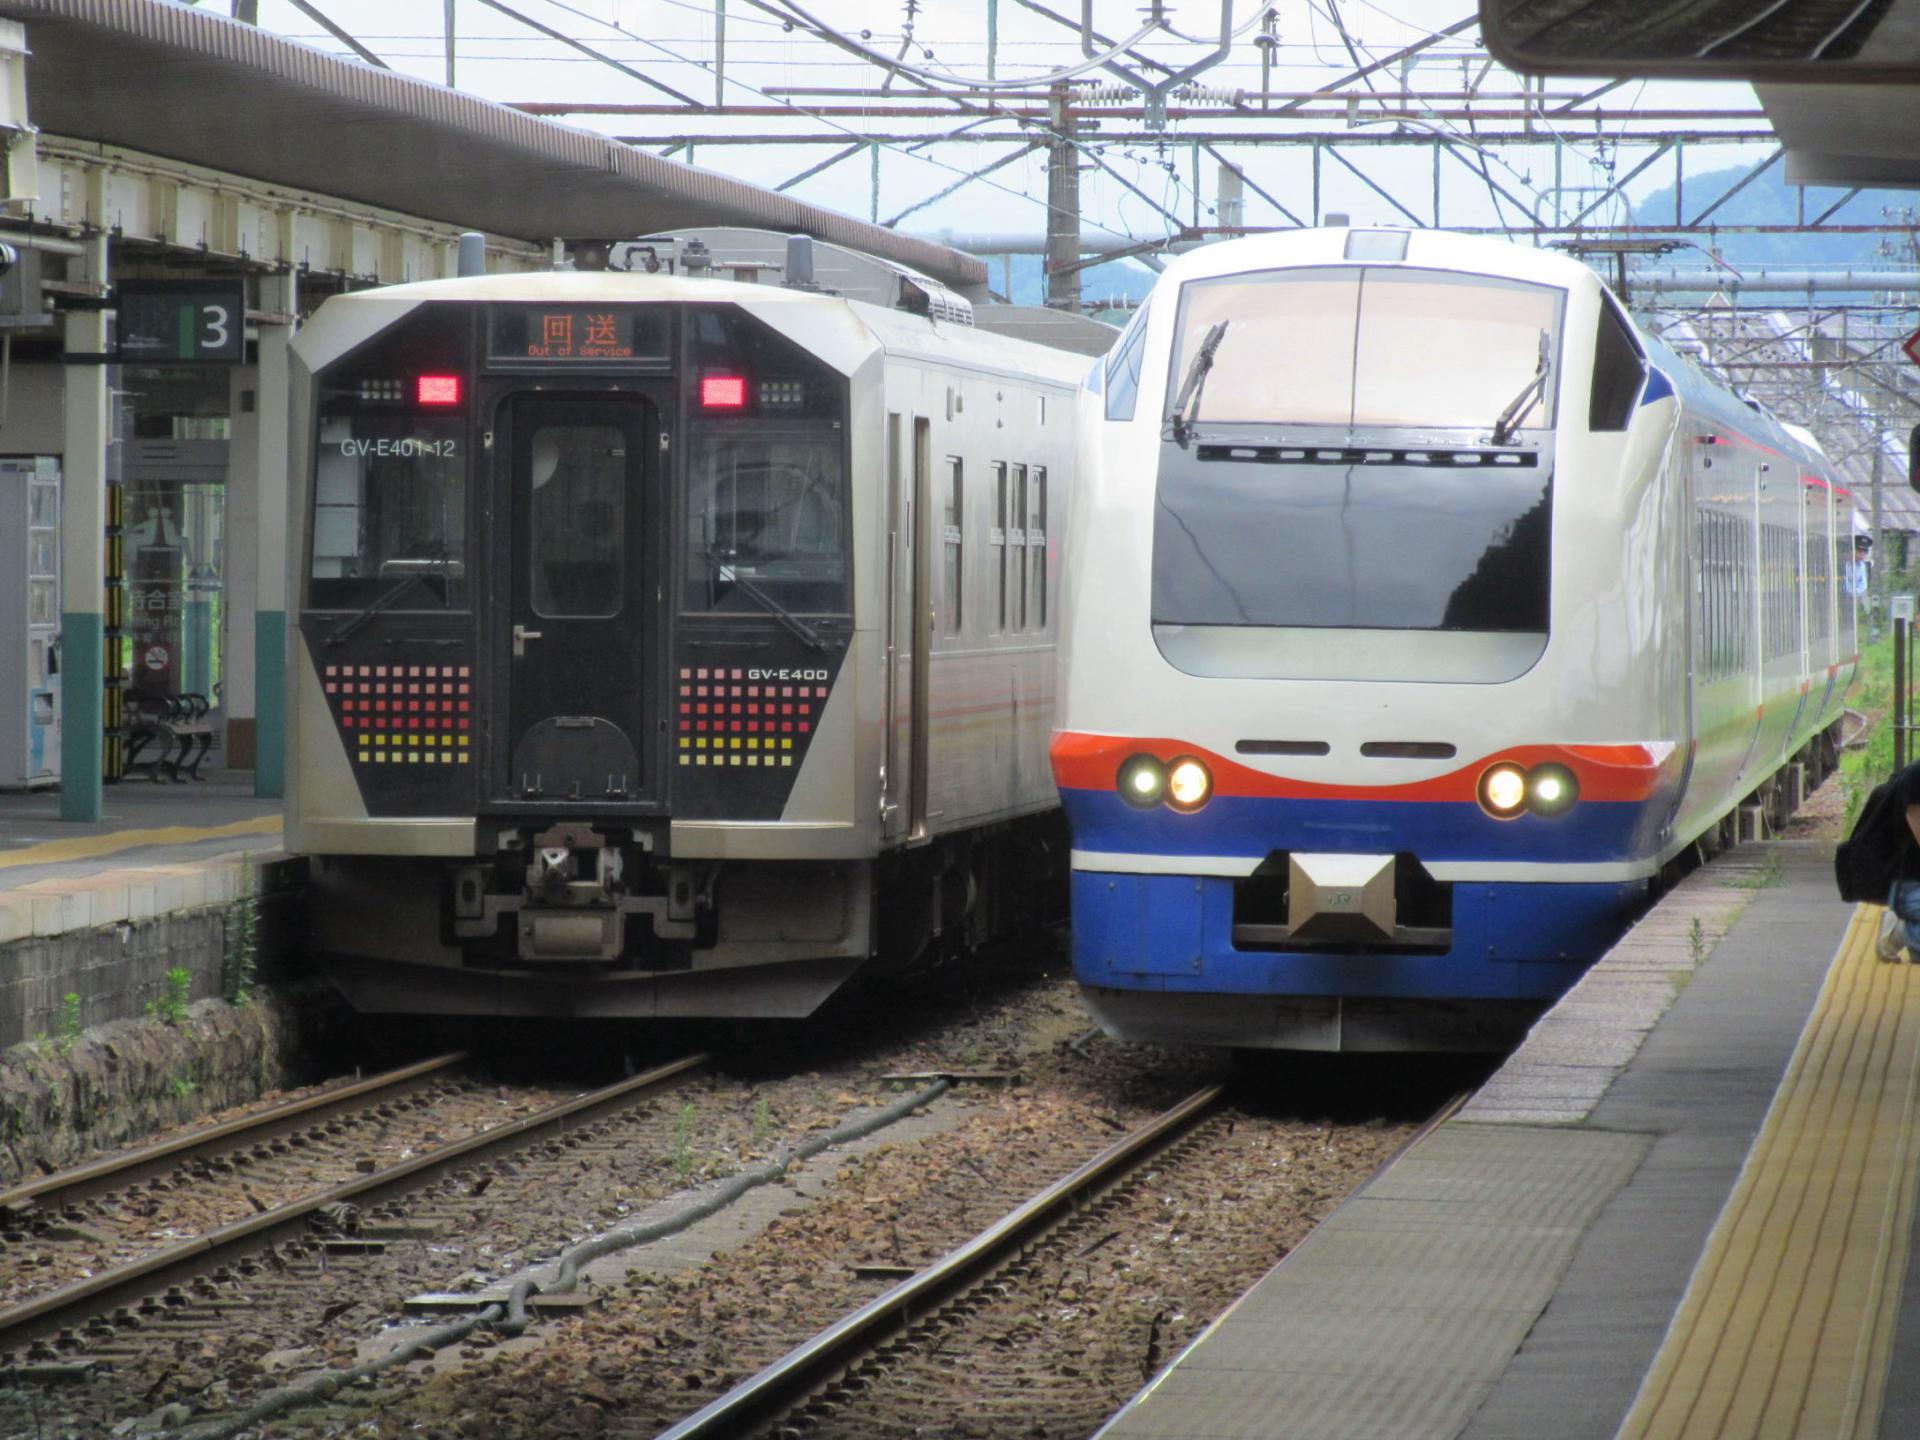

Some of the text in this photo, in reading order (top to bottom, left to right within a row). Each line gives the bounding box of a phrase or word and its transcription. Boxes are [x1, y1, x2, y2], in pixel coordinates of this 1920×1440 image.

[201, 305, 229, 348] 3
[543, 312, 616, 345] 回送
[528, 344, 632, 356] Out of Service
[341, 438, 456, 456] GV-E401-12
[748, 669, 828, 681] GV-E400
